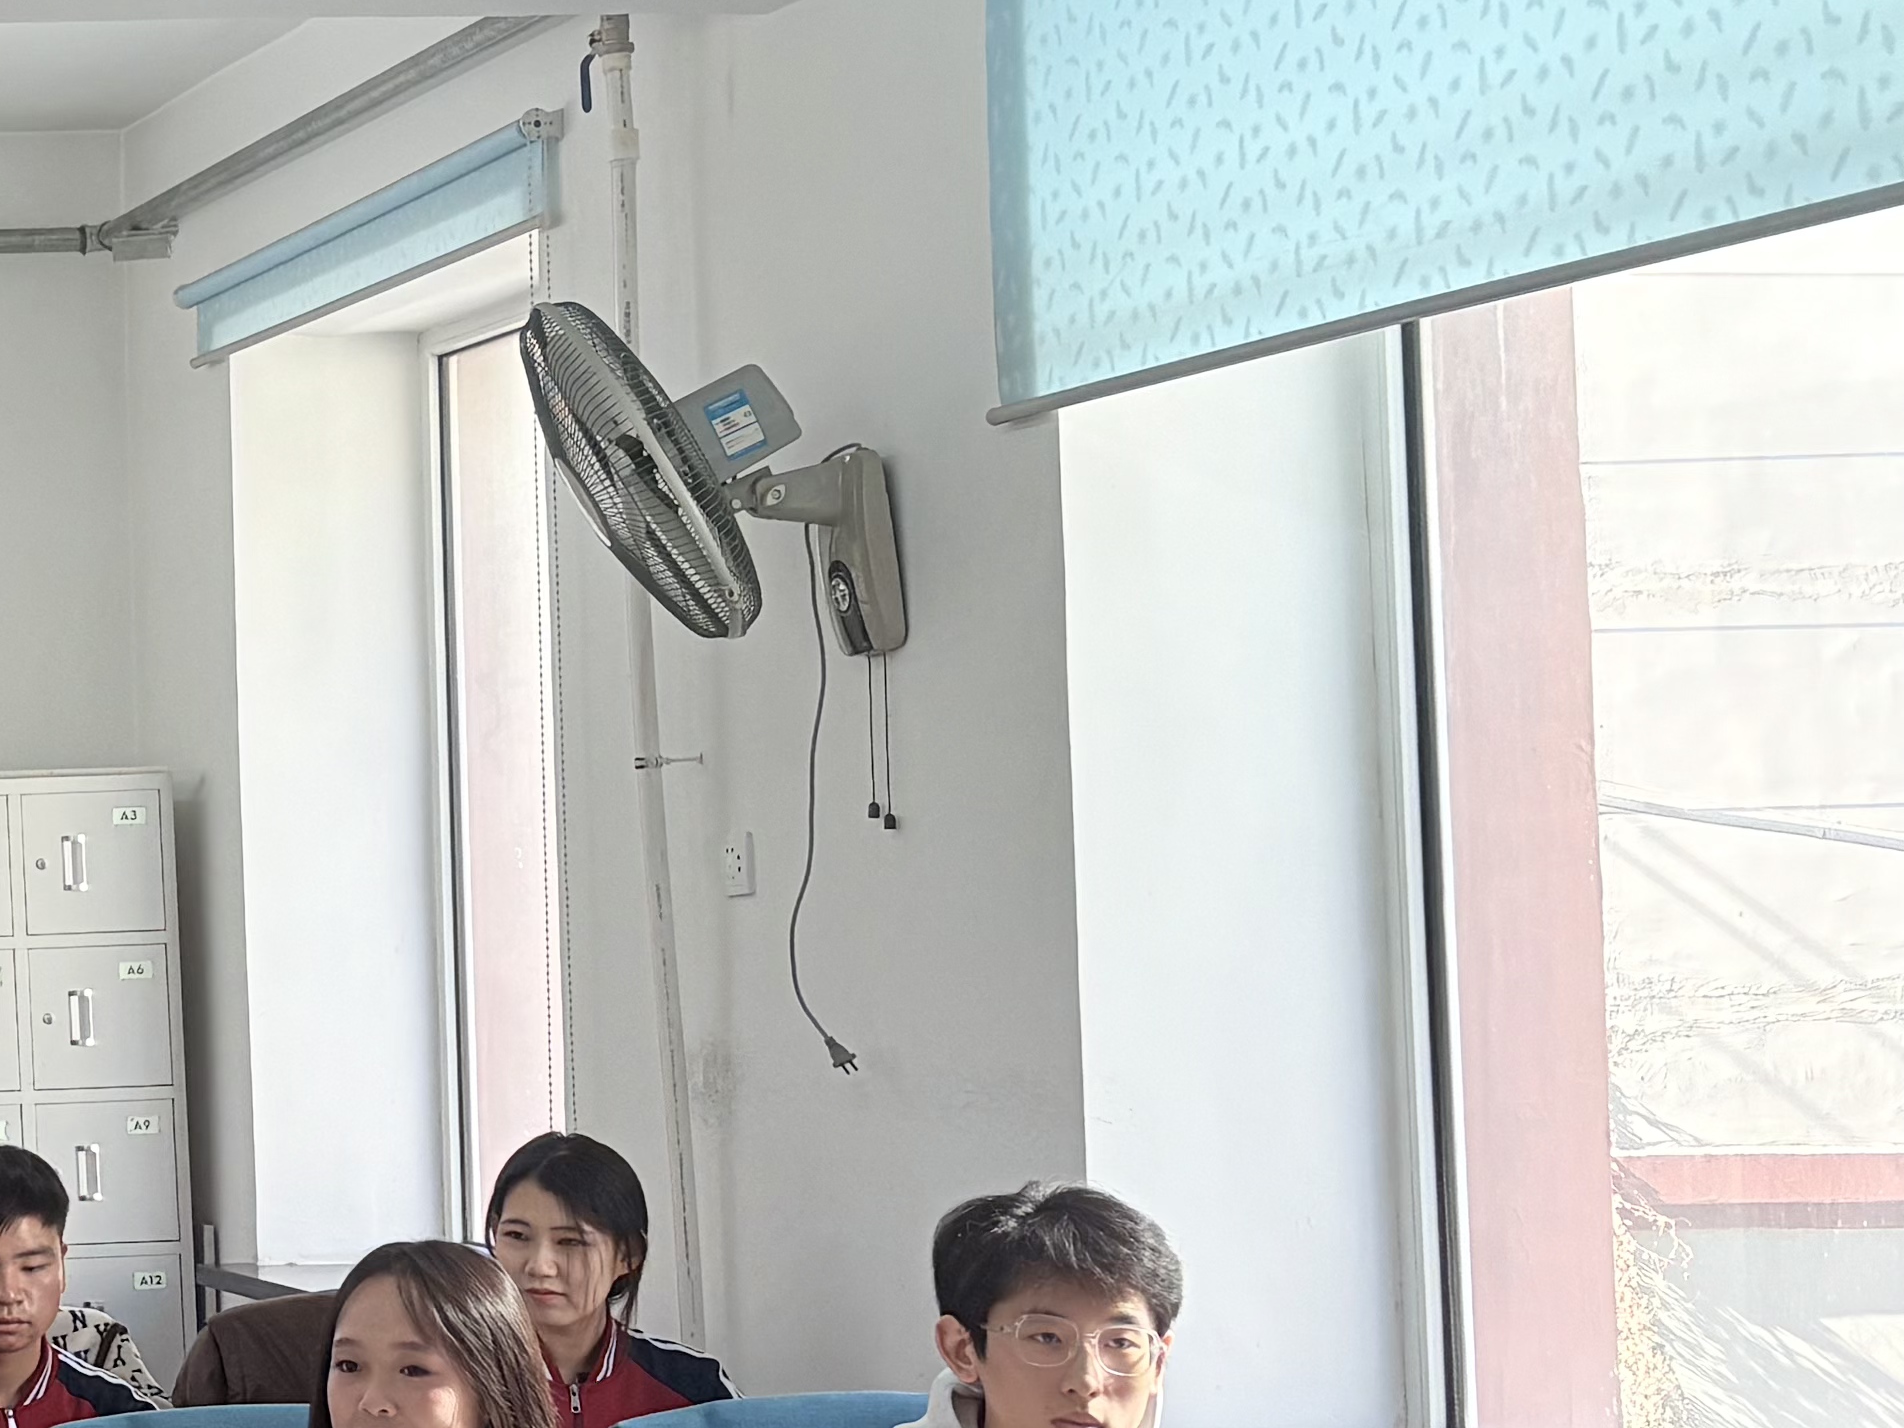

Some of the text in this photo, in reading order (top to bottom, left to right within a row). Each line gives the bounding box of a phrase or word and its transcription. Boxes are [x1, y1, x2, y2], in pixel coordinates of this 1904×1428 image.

[120, 809, 138, 821] A3
[127, 964, 145, 976] A6
[133, 1119, 151, 1131] A9
[140, 1274, 163, 1287] A12
